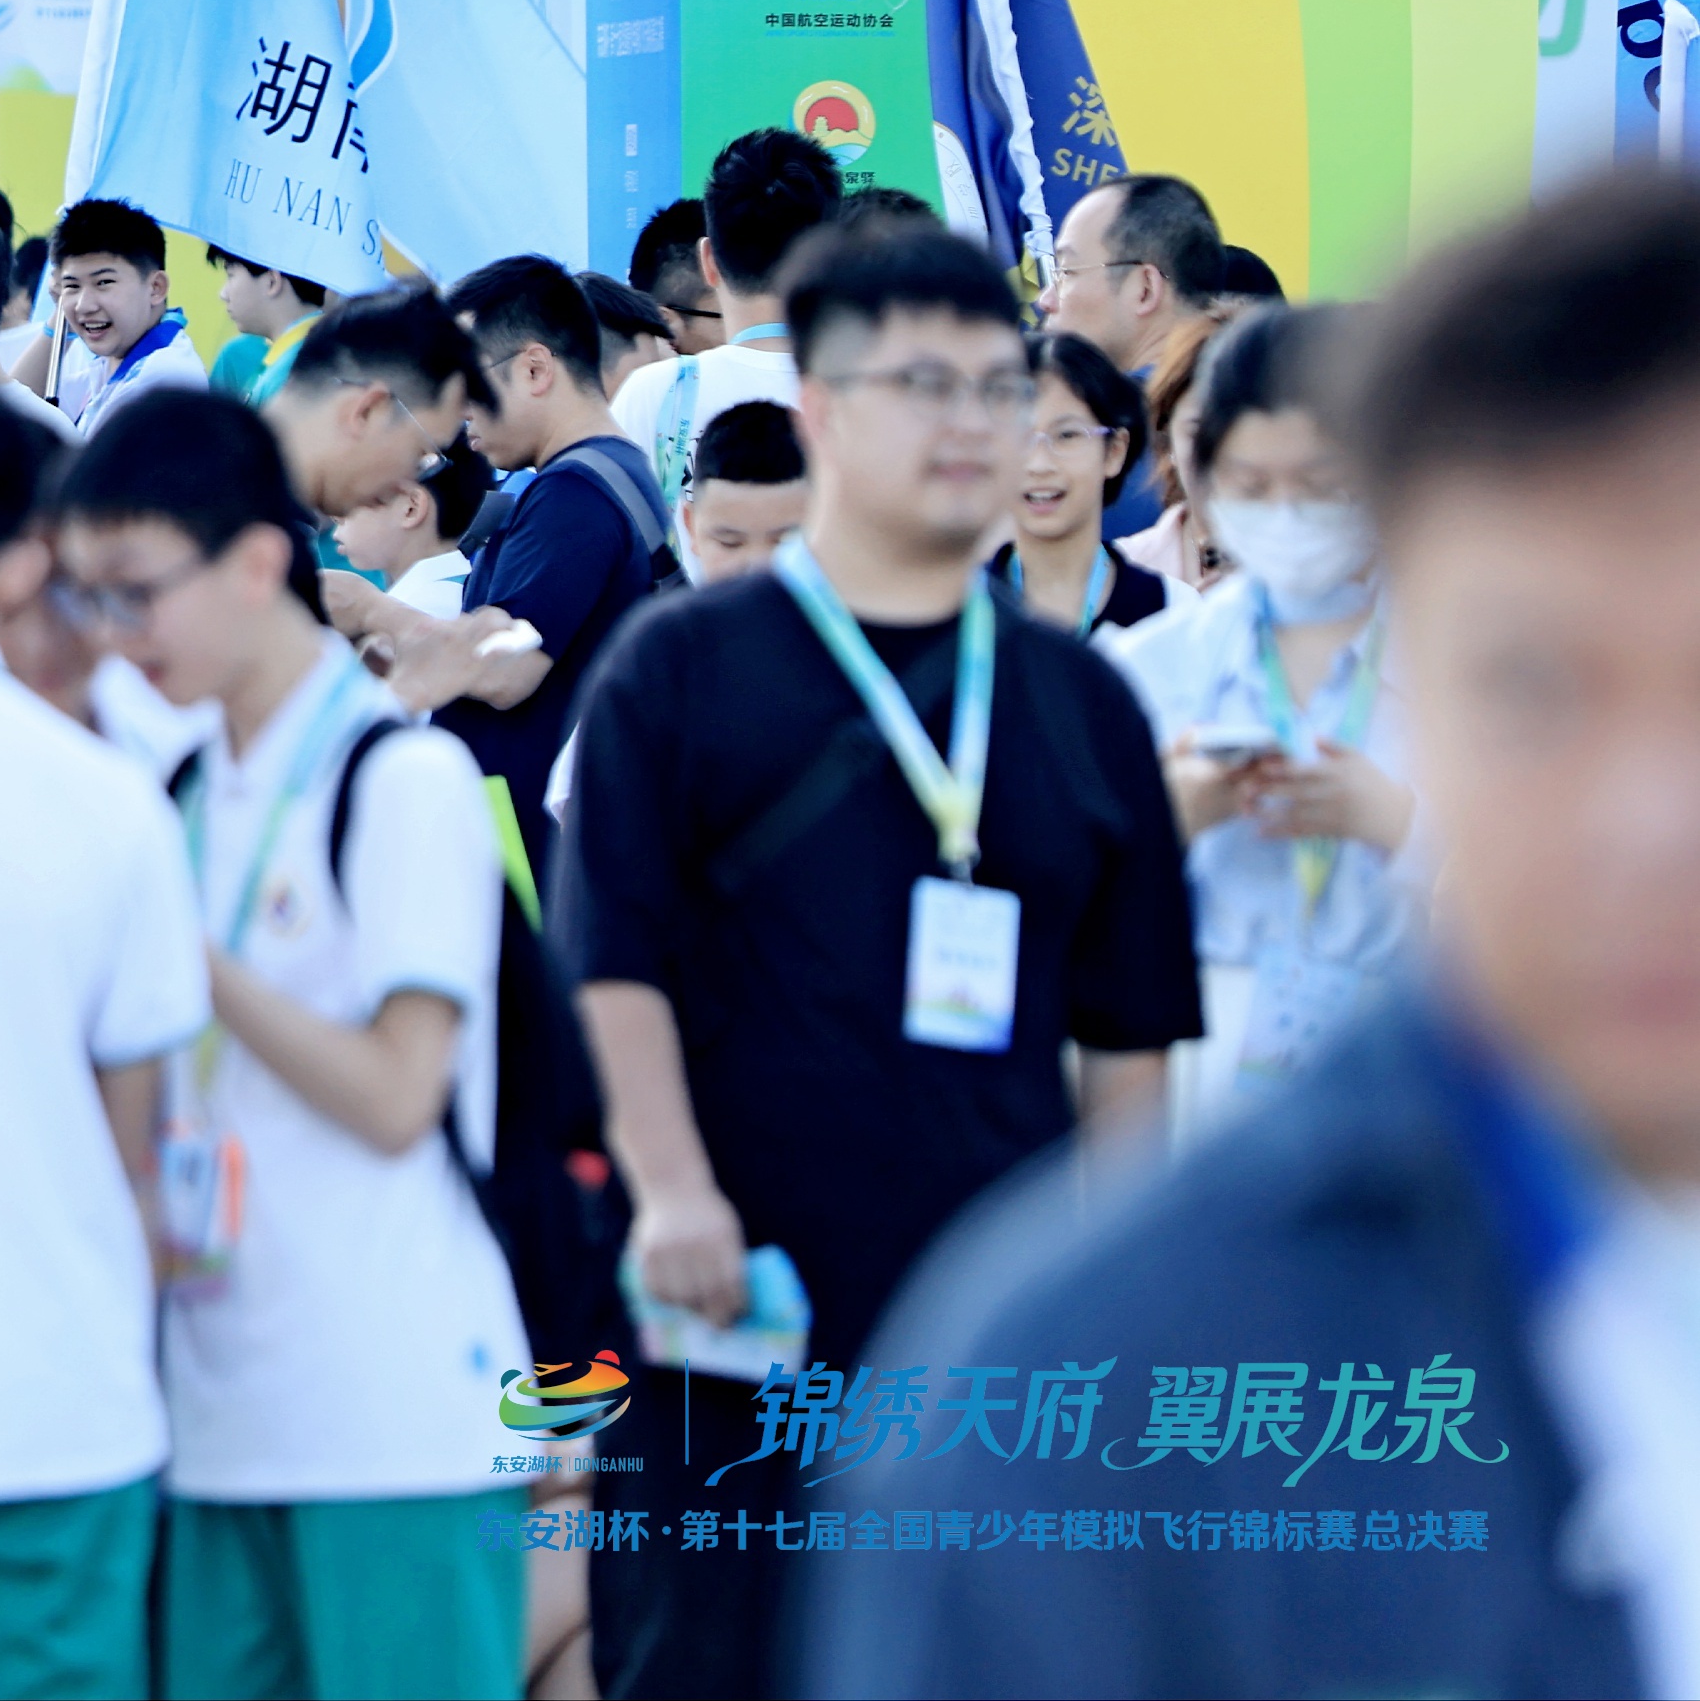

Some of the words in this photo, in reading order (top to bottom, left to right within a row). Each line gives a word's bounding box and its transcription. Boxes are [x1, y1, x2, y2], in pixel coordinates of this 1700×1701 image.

[765, 13, 894, 28] 中国航空运动协会
[224, 158, 263, 204] HU
[272, 176, 352, 236] NAN
